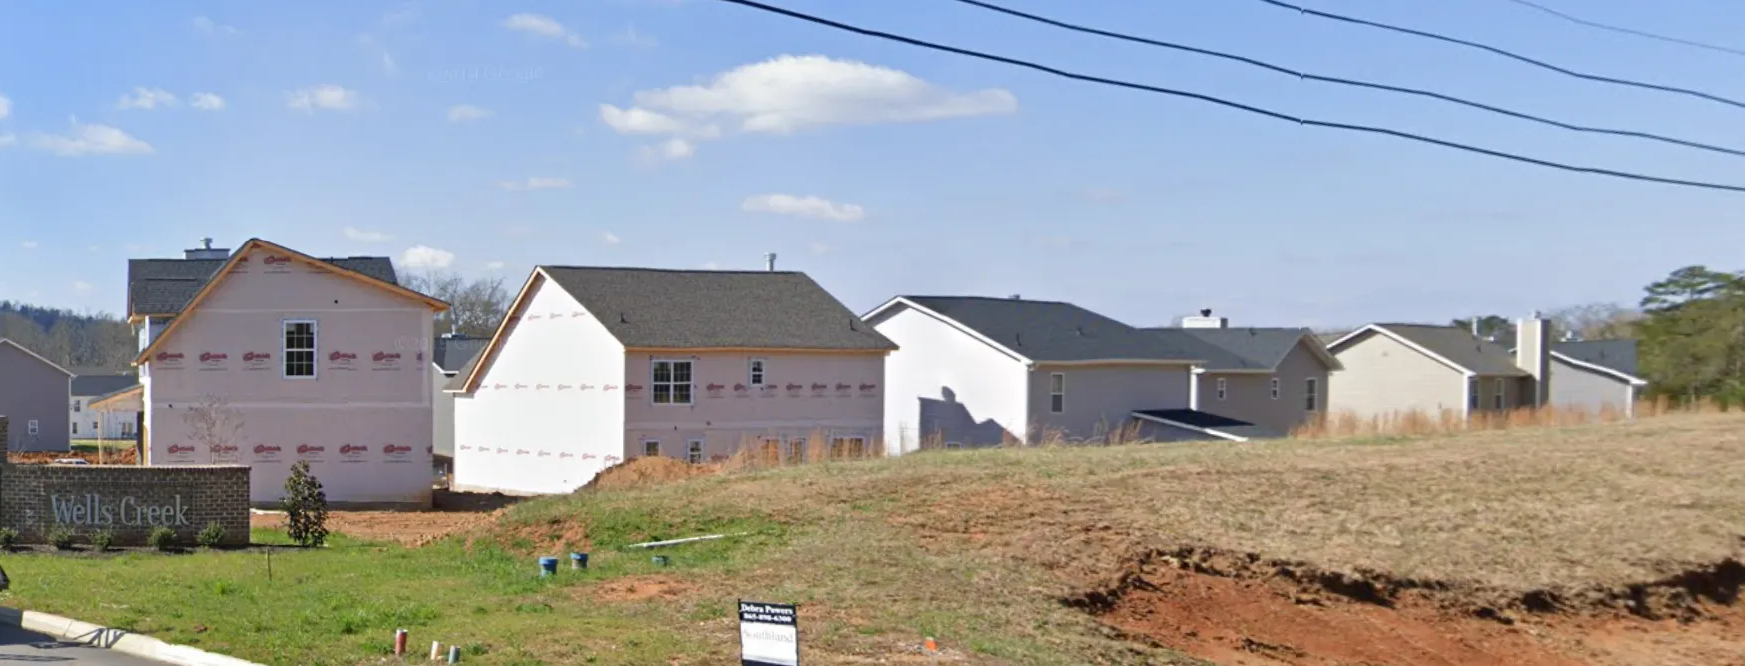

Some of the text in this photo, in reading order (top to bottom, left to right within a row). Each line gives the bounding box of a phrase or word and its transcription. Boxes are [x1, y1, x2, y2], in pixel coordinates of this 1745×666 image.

[51, 493, 190, 526] Wells Creek
[741, 603, 793, 615] Debra Powers
